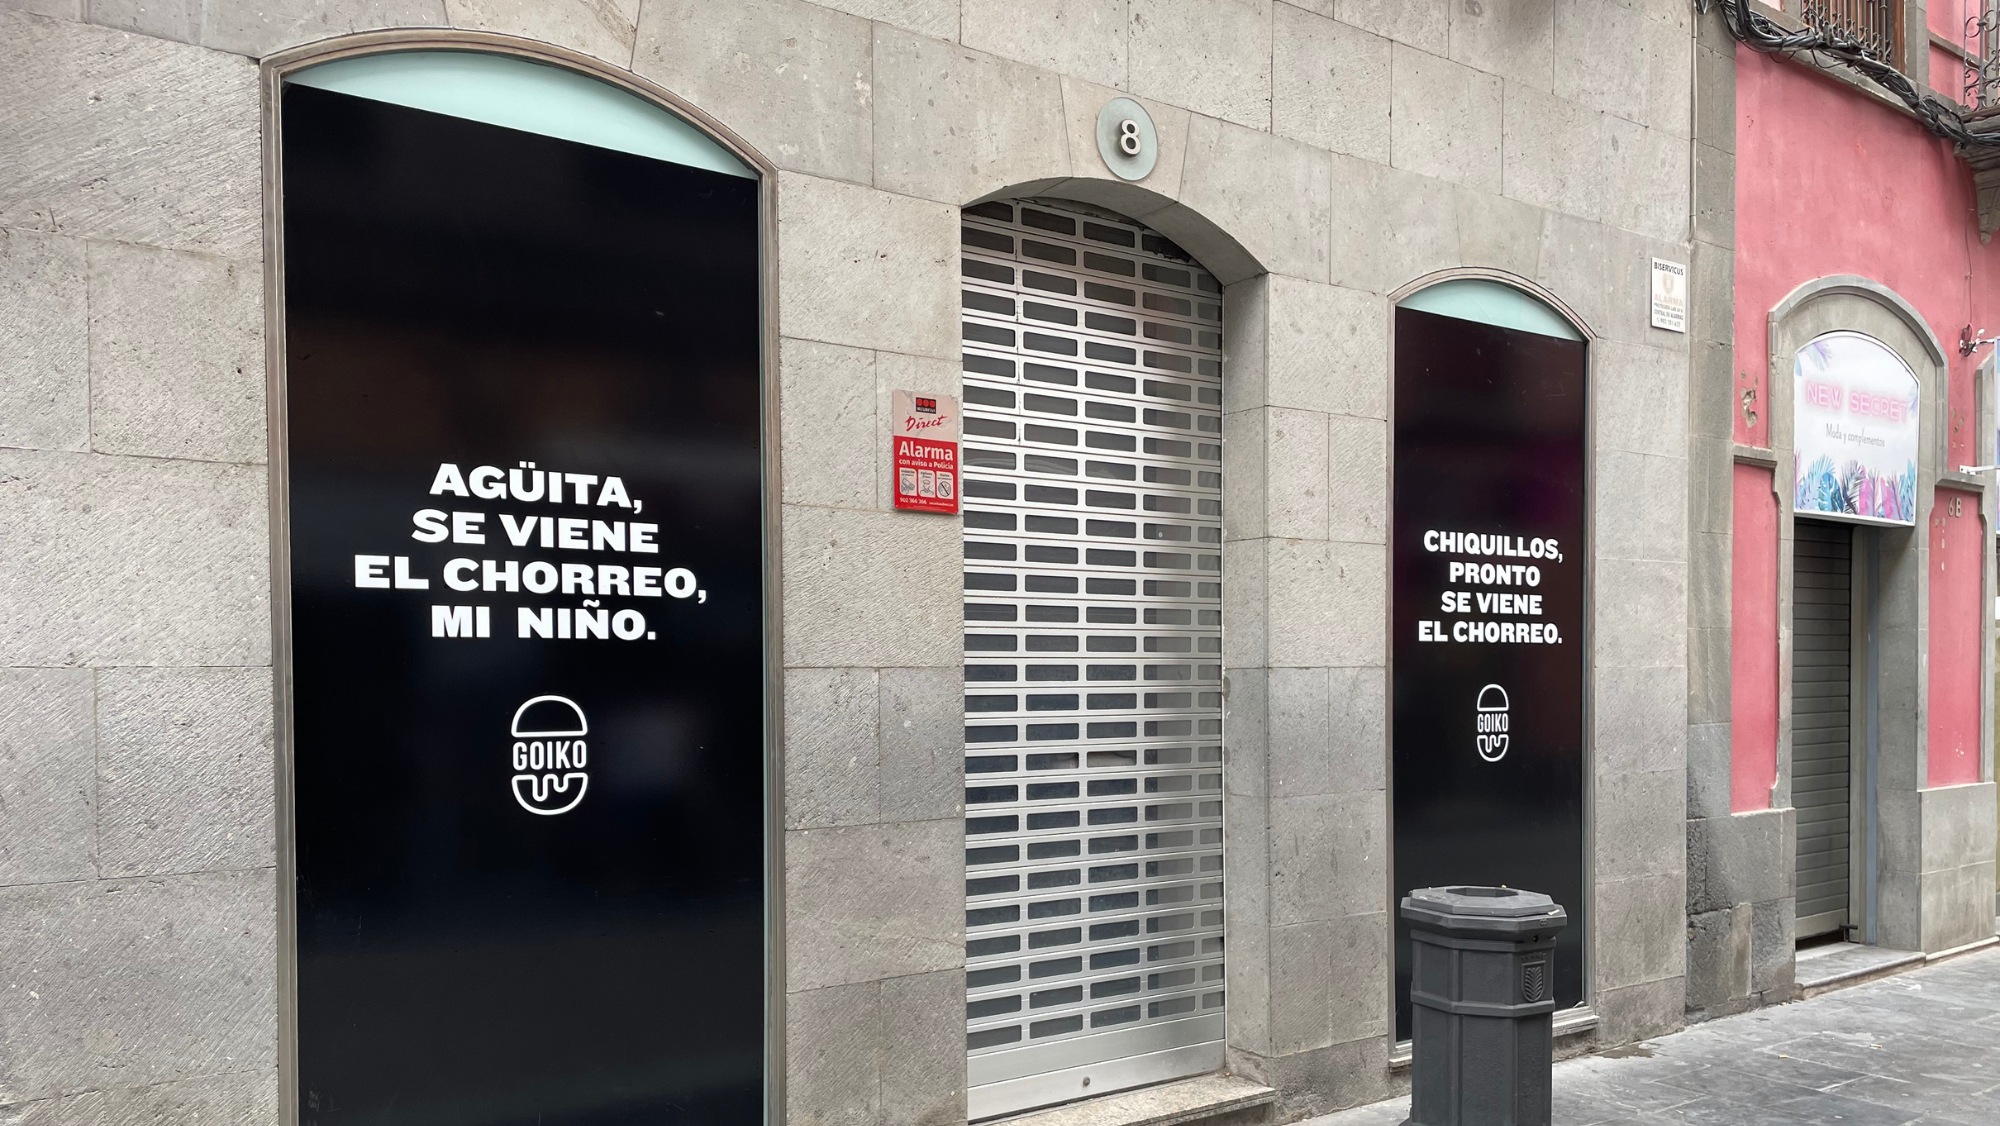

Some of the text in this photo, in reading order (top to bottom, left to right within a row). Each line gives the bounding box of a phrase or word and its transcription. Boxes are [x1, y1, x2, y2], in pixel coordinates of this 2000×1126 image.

[1119, 119, 1141, 156] 8
[1654, 261, 1684, 276] BISERVICUS
[1654, 293, 1683, 307] ALARMA
[1806, 382, 1909, 423] NEW SECRET
[905, 415, 948, 432] Direct
[1826, 423, 1885, 447] Moda y complementos
[899, 441, 953, 461] Alarma
[429, 461, 642, 514] AGÜITA,
[411, 509, 659, 553] SE VIENE
[1423, 529, 1563, 563] CHIQUILLOS,
[354, 554, 706, 604] EL CHORREO,
[1449, 562, 1540, 587] PRONTO
[1441, 591, 1542, 615] SE VIENE
[431, 599, 656, 640] MI NIÑO.
[1419, 621, 1562, 644] EL CHORREO.
[1477, 713, 1508, 732] GOIKO
[513, 741, 587, 771] GOIKO
